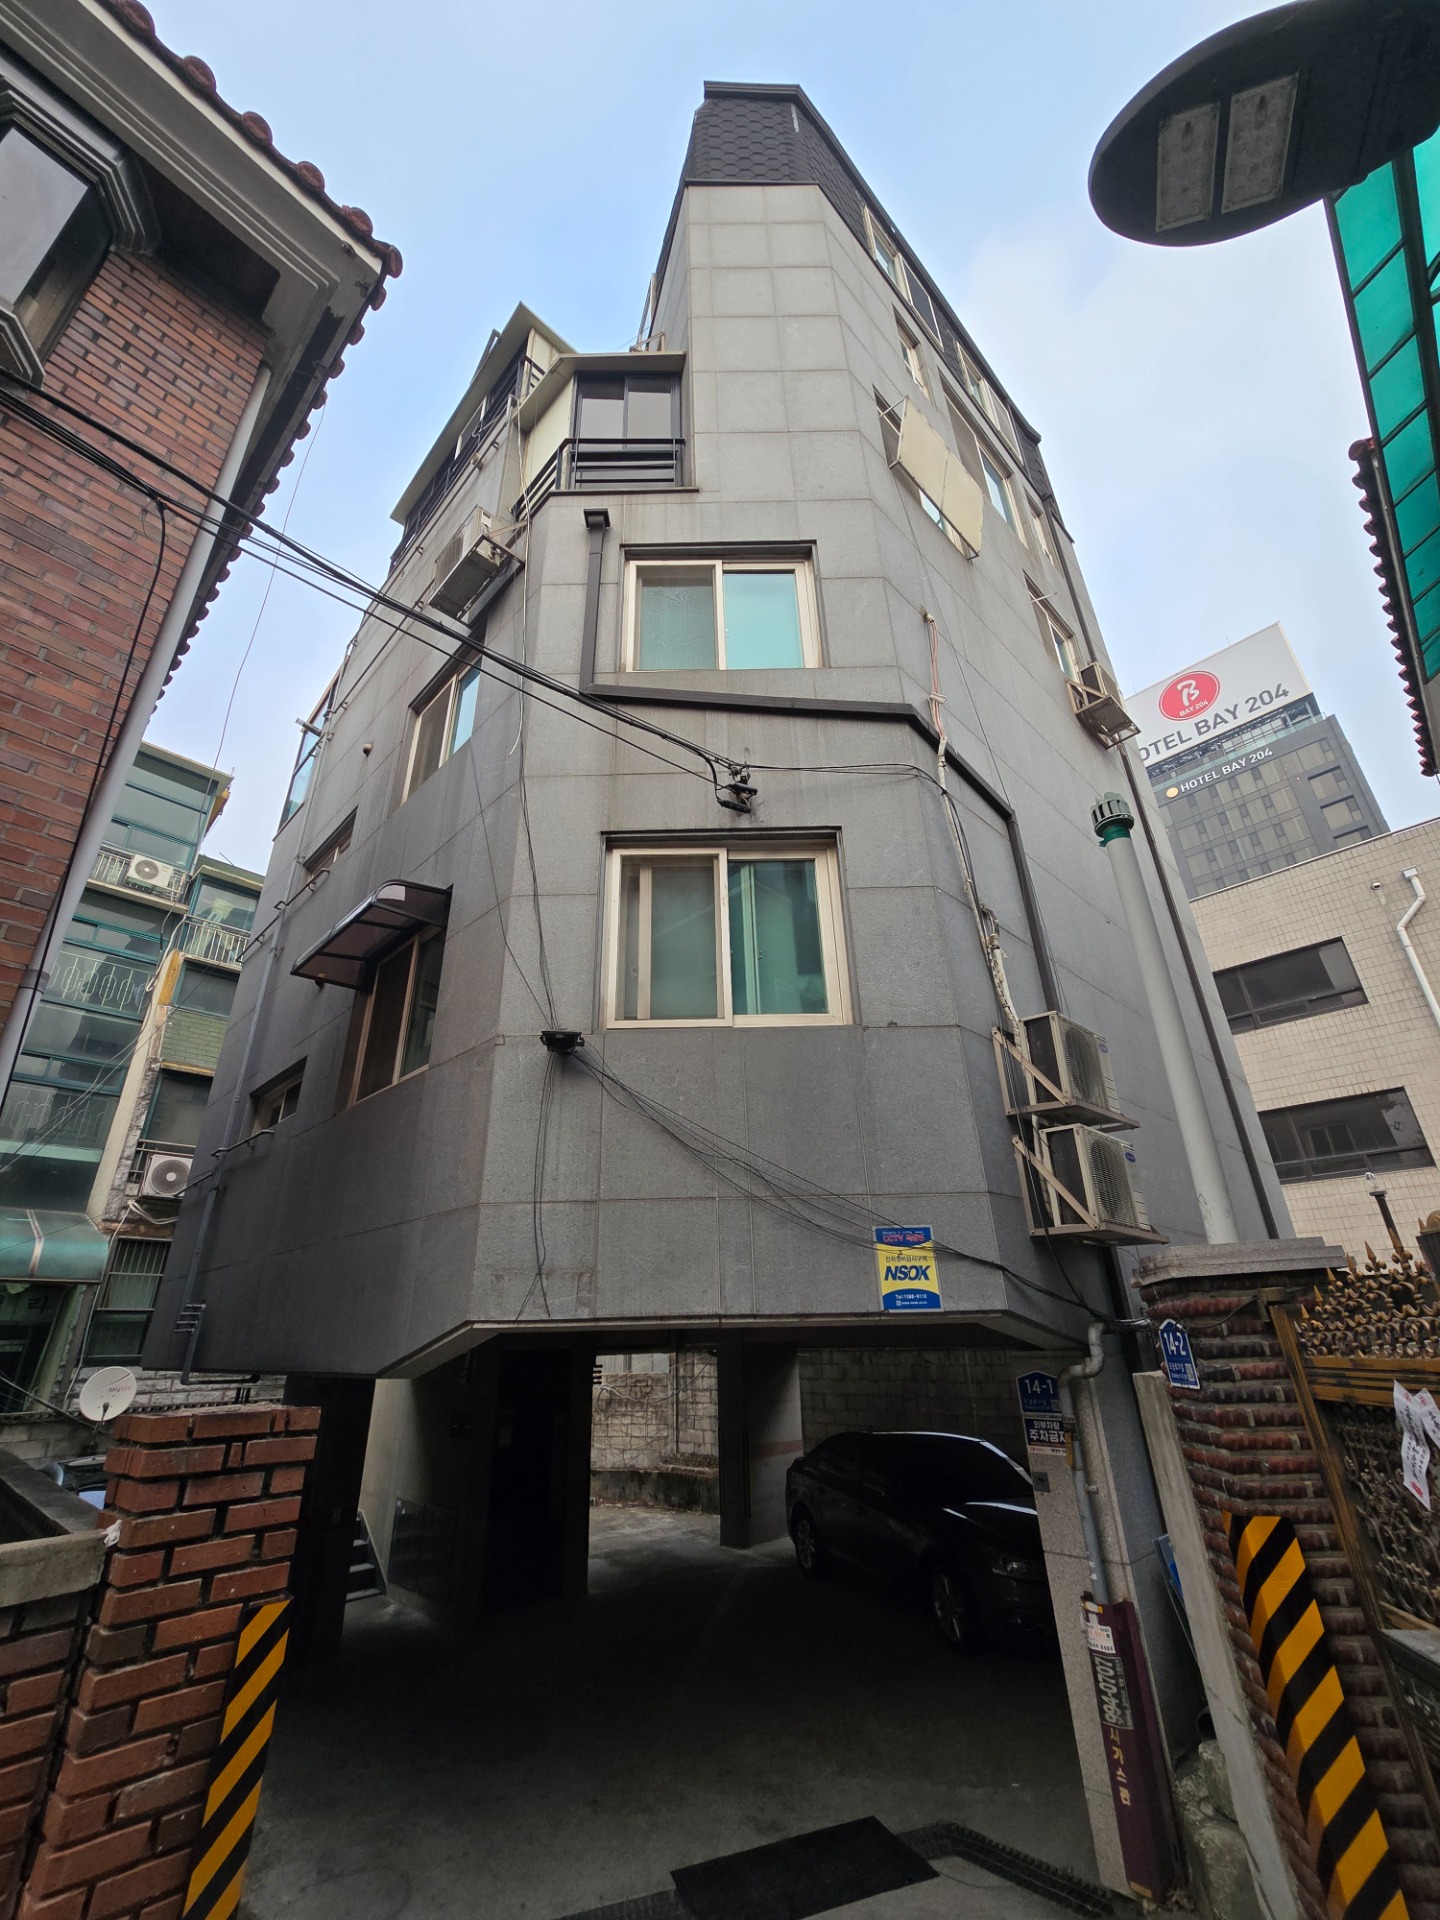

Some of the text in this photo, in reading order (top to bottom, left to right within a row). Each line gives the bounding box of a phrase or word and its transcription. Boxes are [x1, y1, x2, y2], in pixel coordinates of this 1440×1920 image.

[1179, 699, 1209, 717] BAY 204
[1194, 703, 1239, 736] BAY
[1245, 683, 1290, 713] 204
[1180, 747, 1273, 793] HOTEL BAY 204
[884, 1265, 931, 1281] NSOK
[1163, 1331, 1187, 1356] 14-2
[1024, 1379, 1054, 1395] 14-1
[1033, 1420, 1060, 1431] 외부차량
[1093, 1656, 1122, 1726] 994-0707
